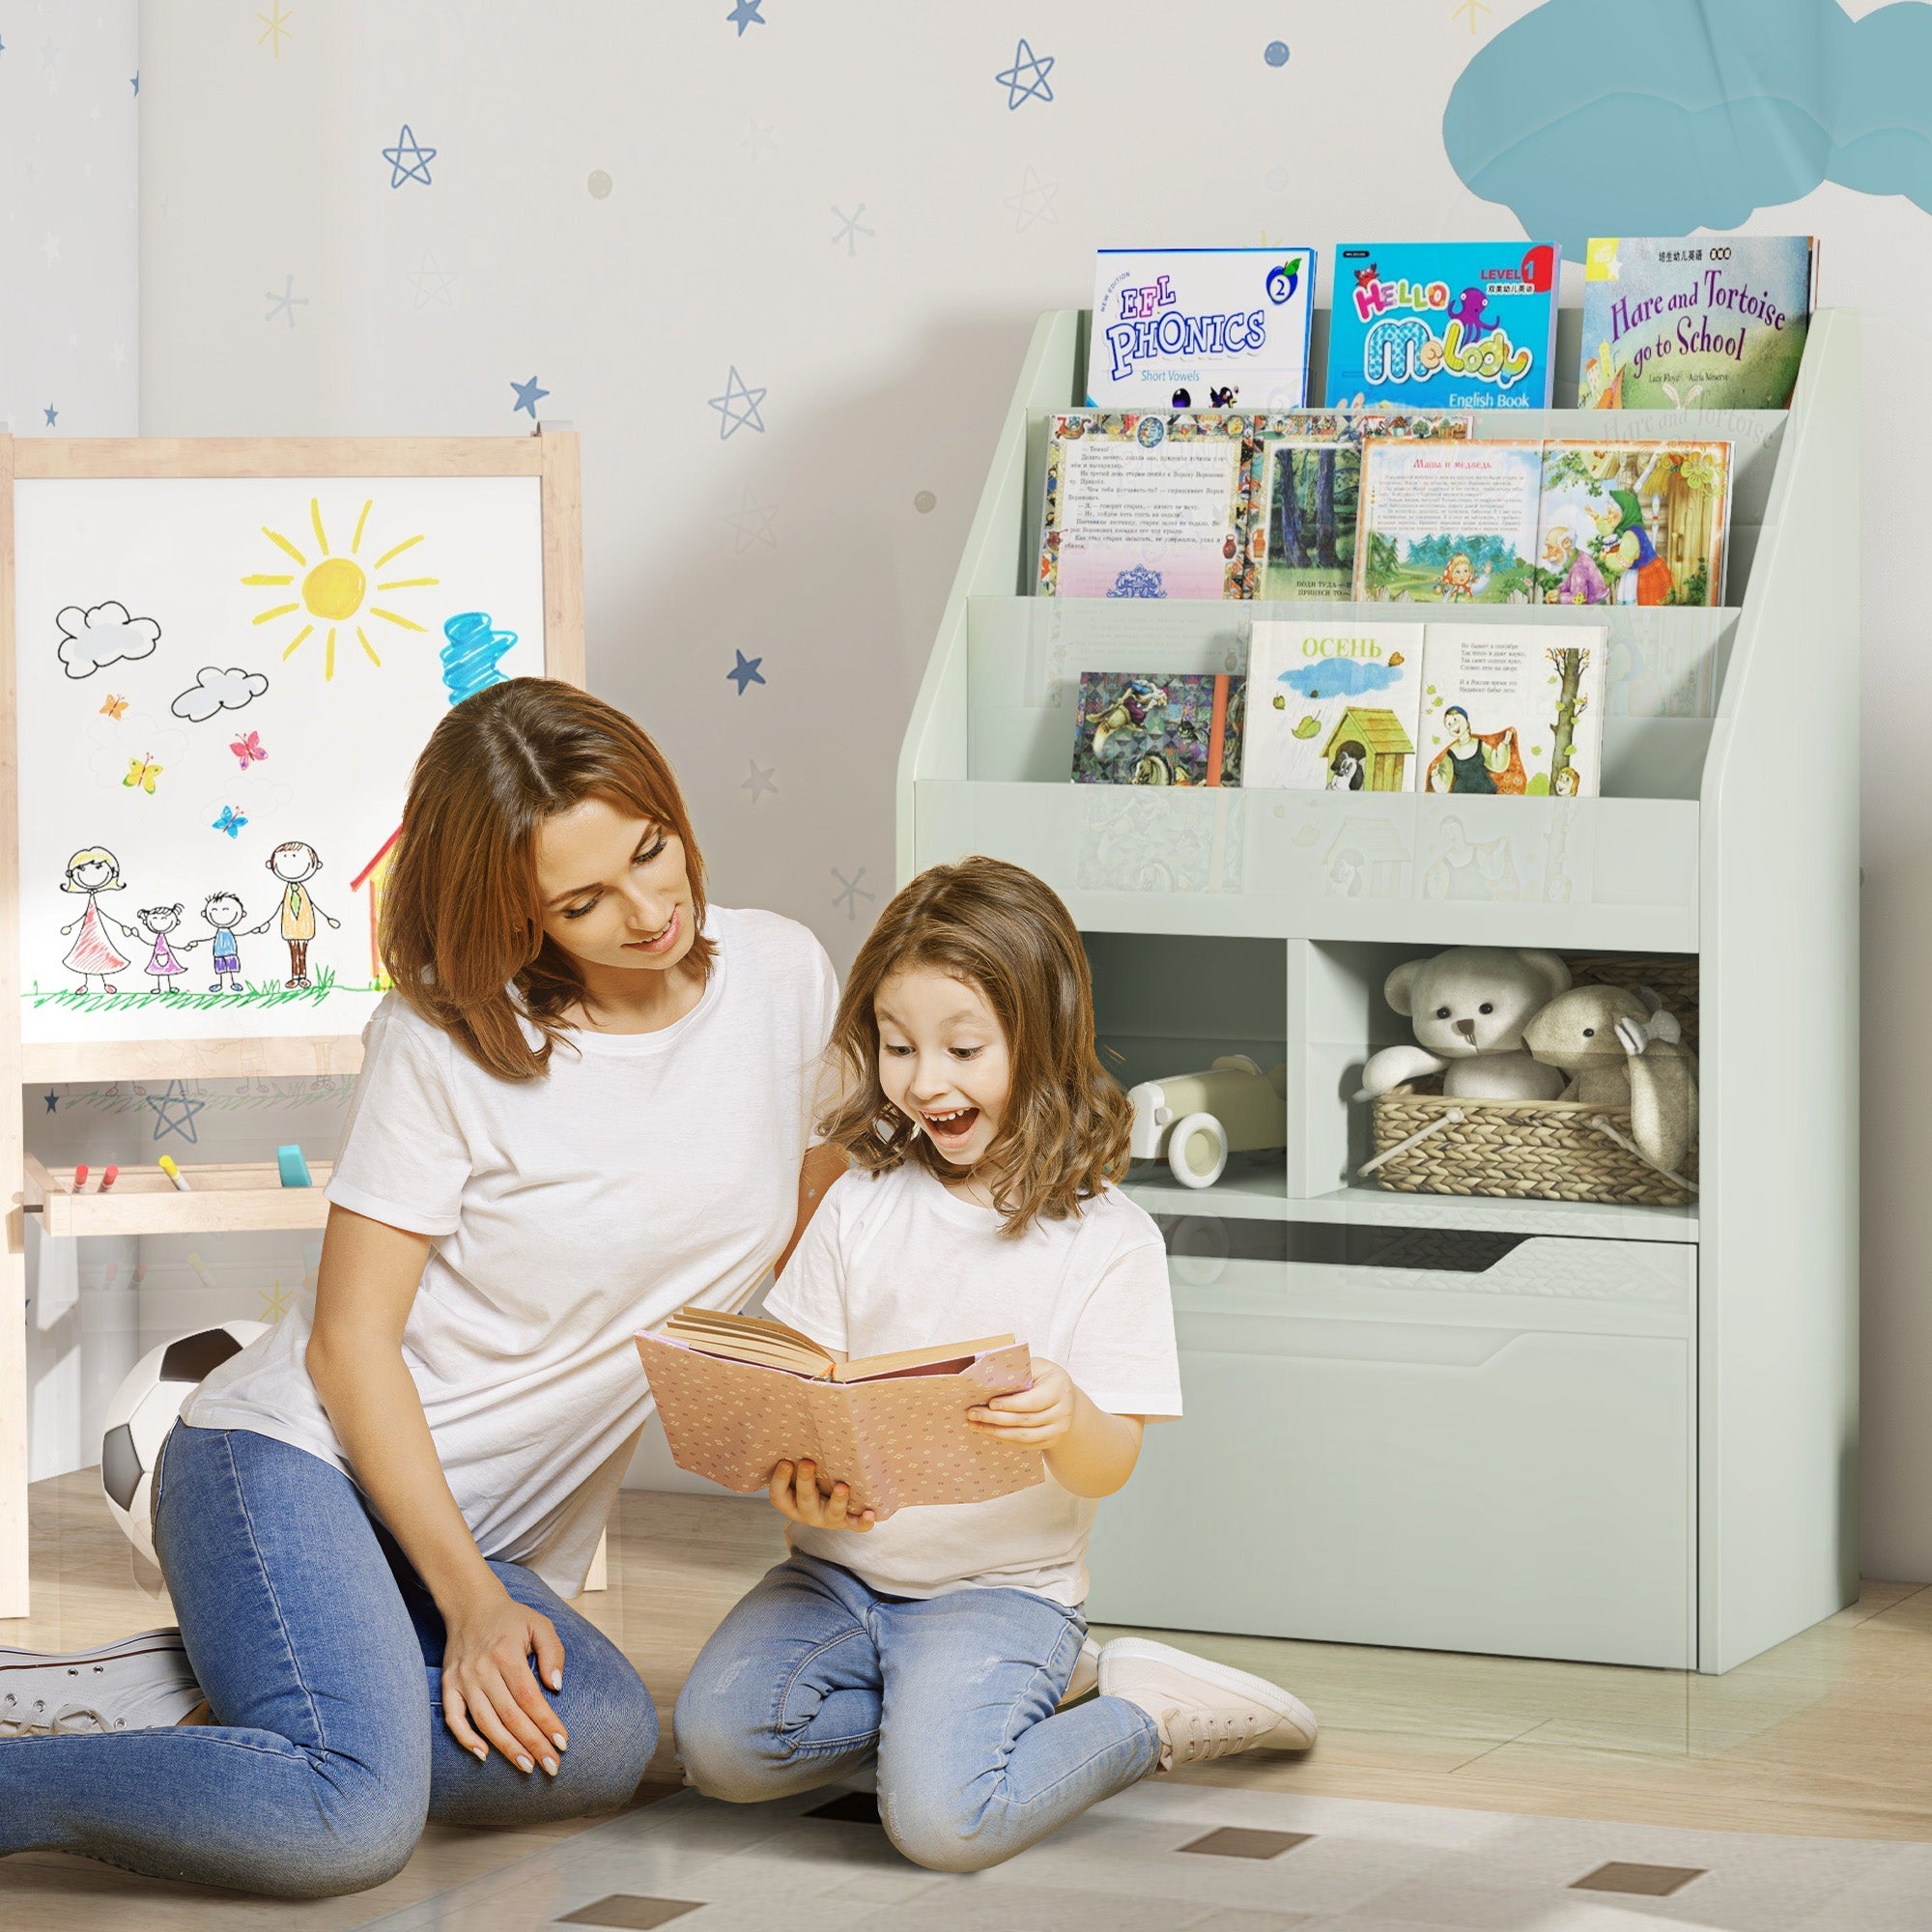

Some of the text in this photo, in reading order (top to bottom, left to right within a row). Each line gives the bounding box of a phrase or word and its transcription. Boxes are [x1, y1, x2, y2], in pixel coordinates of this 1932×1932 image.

[1481, 261, 1535, 280] LEVEL 1
[1100, 270, 1131, 313] NEW EDITION
[1121, 275, 1176, 320] EFL
[1275, 278, 1287, 297] 2
[1355, 280, 1448, 321] HELLO
[1610, 270, 1786, 344] Hare and Tortoise
[1106, 310, 1265, 381] PHONICS
[1634, 315, 1747, 380] go to School
[1141, 370, 1200, 382] Short Vowels
[1449, 392, 1529, 409] English Book
[1413, 459, 1442, 469] Маша
[1301, 637, 1383, 659] ОСЕНЬ
